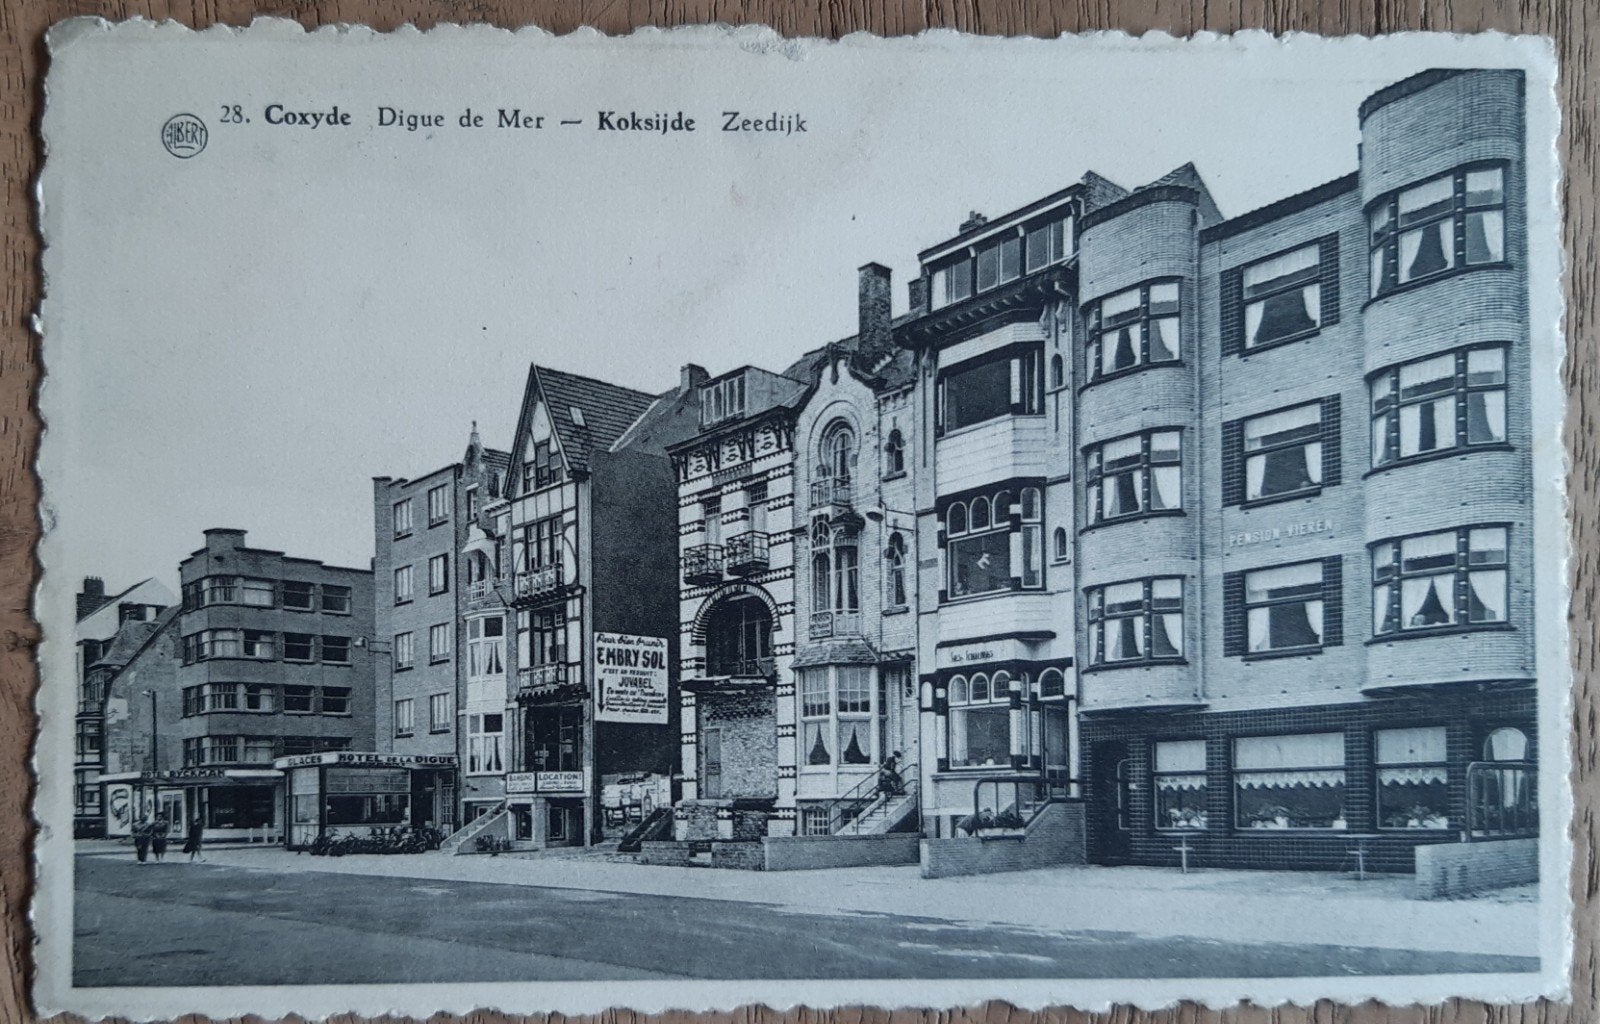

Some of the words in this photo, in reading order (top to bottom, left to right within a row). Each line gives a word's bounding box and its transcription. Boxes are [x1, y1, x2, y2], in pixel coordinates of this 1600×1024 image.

[219, 105, 250, 124] 28.
[264, 104, 352, 130] Coxyde
[378, 107, 445, 132] Digue
[459, 109, 484, 128] de
[498, 110, 545, 129] Mer
[598, 111, 696, 135] Koksijde
[722, 112, 808, 137] Zeedijk
[1230, 528, 1280, 546] PENSION
[1287, 520, 1332, 536] VIEREN
[597, 633, 616, 644] Pour
[618, 635, 635, 645] bien
[288, 755, 322, 766] GLACES
[338, 753, 382, 763] HOTEL
[415, 756, 456, 764] DIGUE
